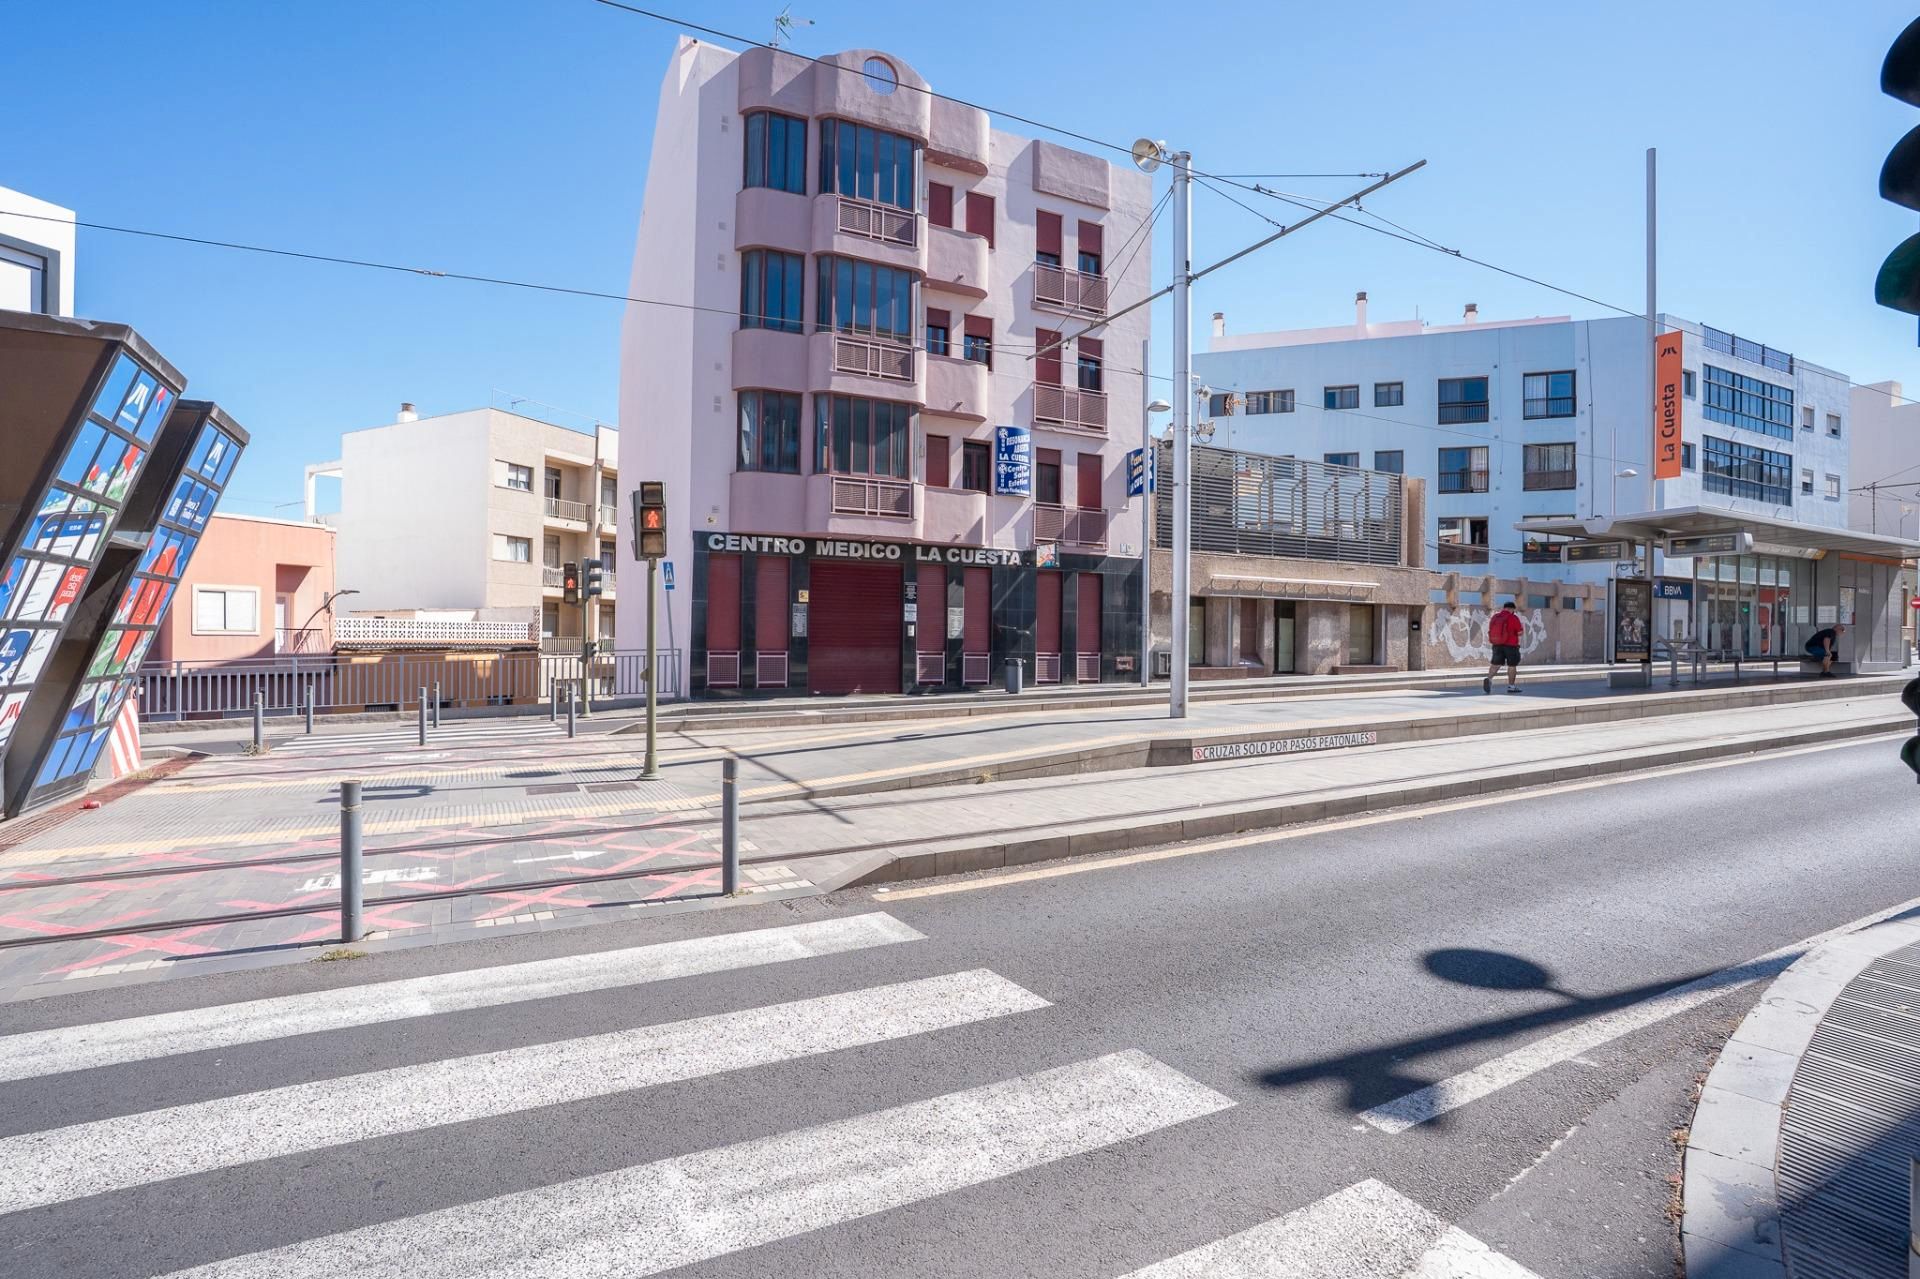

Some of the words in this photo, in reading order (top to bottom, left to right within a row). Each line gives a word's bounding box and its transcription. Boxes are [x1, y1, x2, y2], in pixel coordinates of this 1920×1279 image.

[1660, 383, 1676, 439] Cuesta
[1661, 443, 1676, 462] La
[1007, 465, 1027, 473] Centro
[708, 534, 804, 553] CENTRO
[816, 541, 901, 560] MEDICO
[915, 546, 942, 562] LA
[947, 547, 1021, 566] CUESTA
[1664, 585, 1682, 596] BBVA
[1203, 745, 1241, 760] CRUZAR
[1243, 742, 1267, 756] SOLO
[1270, 740, 1288, 754] POR
[1290, 737, 1316, 751] PASOS
[1319, 732, 1369, 748] PEATONALES
